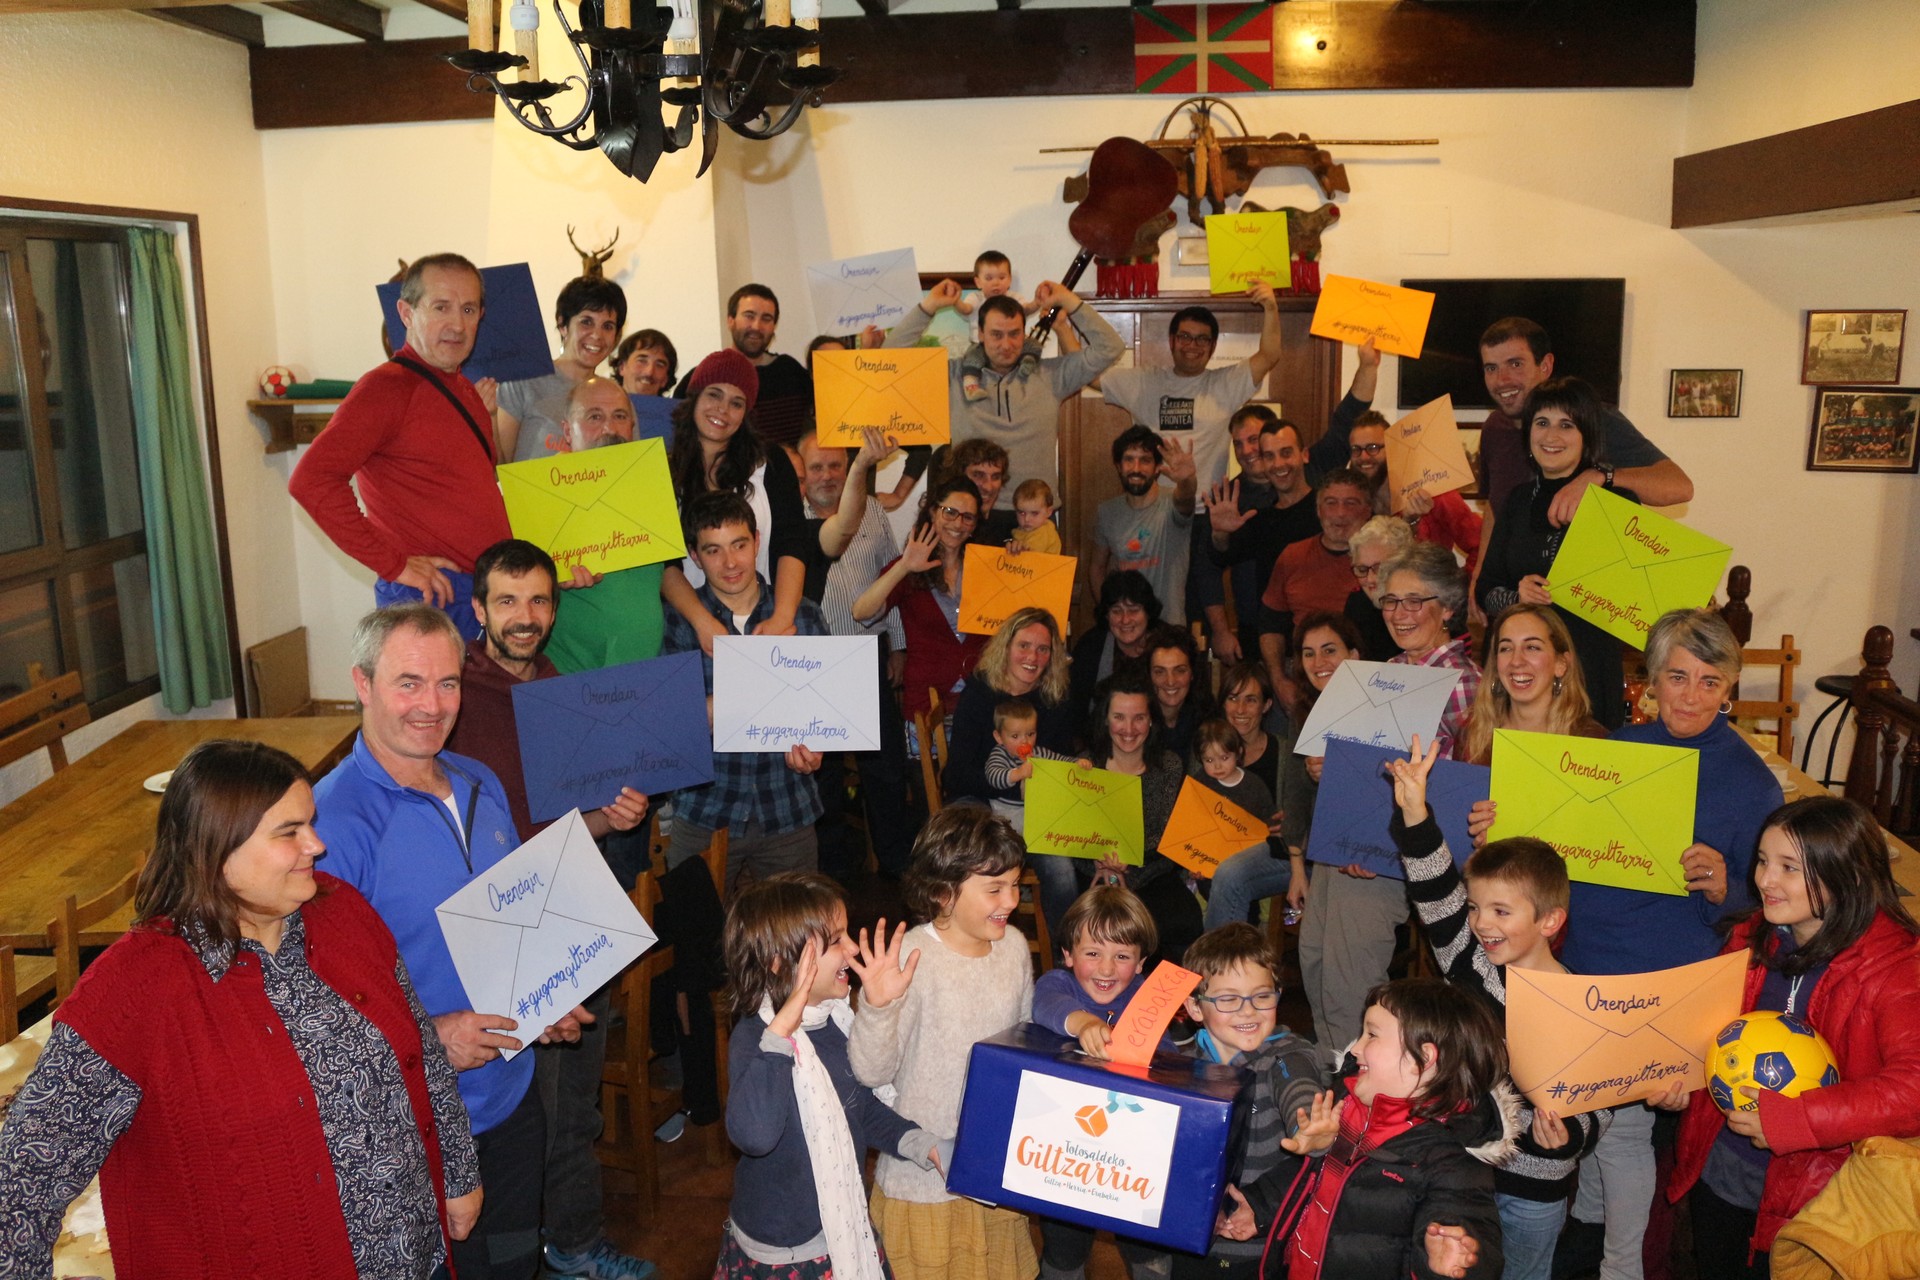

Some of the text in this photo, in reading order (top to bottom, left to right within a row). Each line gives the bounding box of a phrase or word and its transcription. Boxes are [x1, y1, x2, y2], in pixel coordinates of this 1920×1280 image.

[855, 354, 898, 374] Orendain
[549, 465, 608, 487] Orendain
[551, 529, 651, 569] #gugaragiltzarria
[1623, 515, 1670, 557] Orendain
[996, 554, 1034, 580] Orendain
[1569, 582, 1653, 634] #gugaragiltzarr
[770, 644, 822, 671] Orendain
[580, 682, 640, 706] Orendain
[1367, 670, 1406, 692] Orendain
[745, 715, 849, 745] #gugaragiltzarria
[1067, 769, 1107, 795] Orendain
[1559, 751, 1622, 785] Orendain
[1213, 801, 1249, 836] Orendain
[487, 871, 545, 913] Orendain
[516, 934, 614, 1019] #gugaragiltzarria
[1585, 984, 1662, 1014] Orendain
[1551, 1060, 1690, 1104] #gugaragiltzarria
[1016, 1134, 1155, 1200] Giltzarria
[1065, 1139, 1126, 1167] Tolosaldeko
[1066, 1181, 1087, 1194] Herria
[1090, 1188, 1120, 1203] Erabakia
